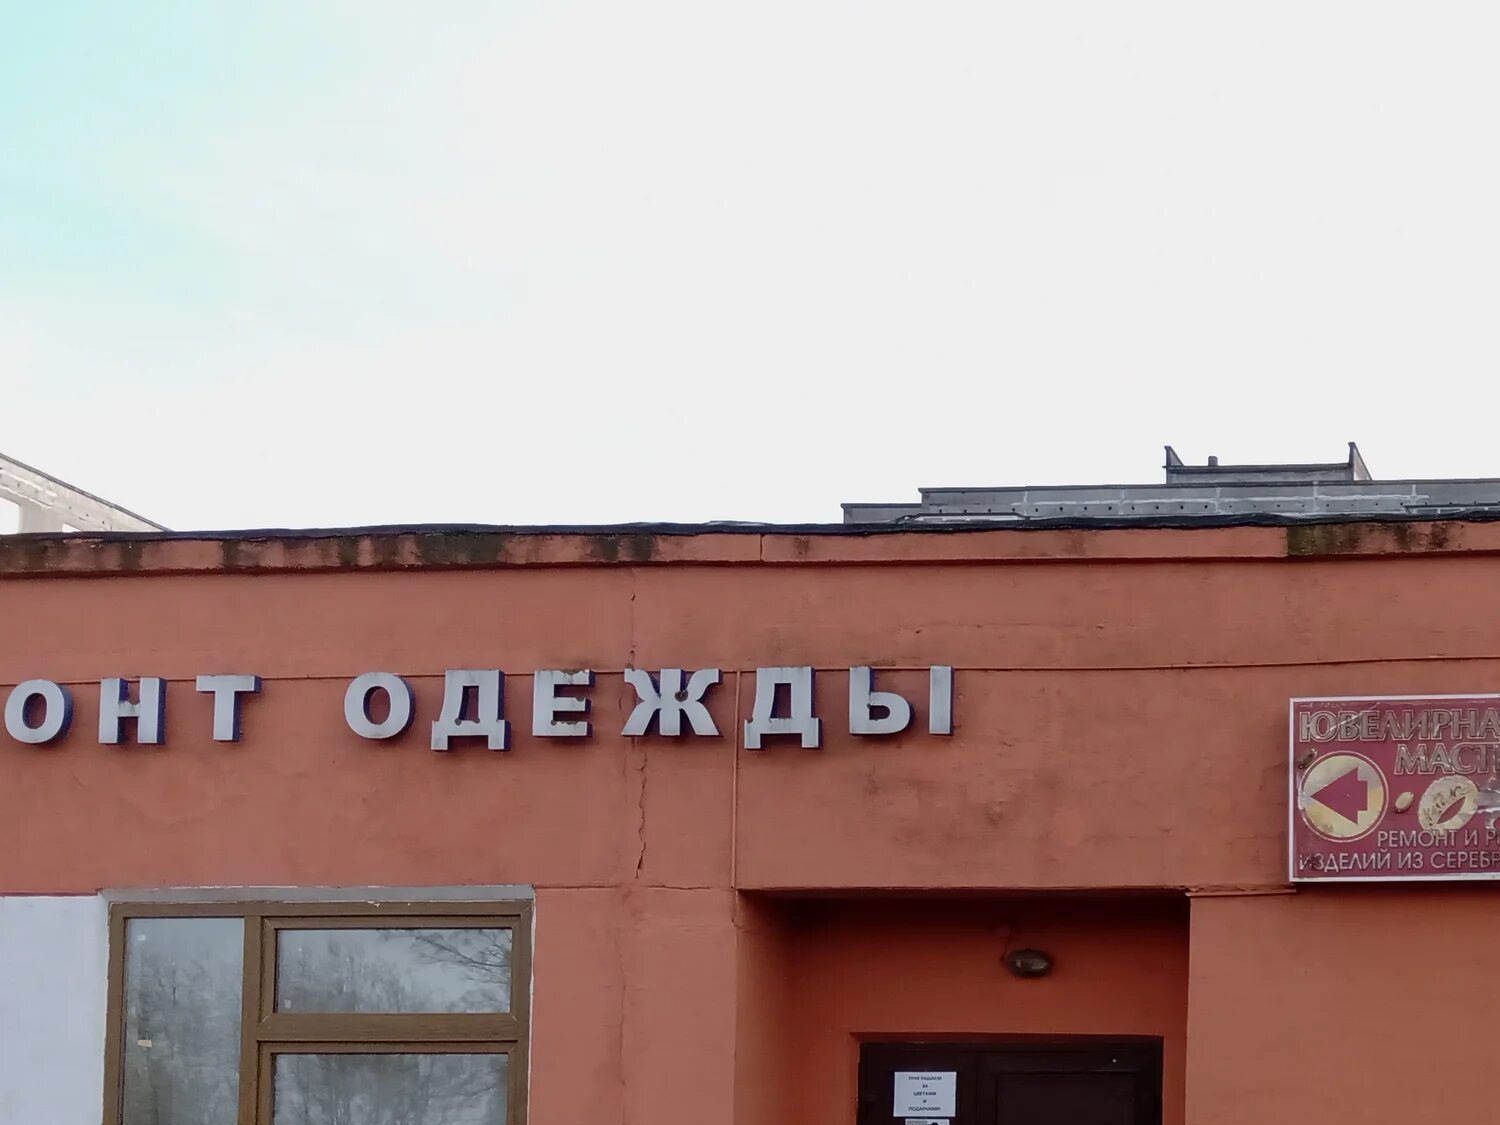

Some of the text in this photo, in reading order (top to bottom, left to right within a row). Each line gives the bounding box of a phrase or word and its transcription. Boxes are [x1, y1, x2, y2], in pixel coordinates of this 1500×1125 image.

[4, 665, 957, 752] ОНТ ОДЕЖДЫ
[1377, 829, 1458, 848] РЕМОНТ
[1464, 828, 1479, 847] И
[1299, 848, 1392, 872] ИЗДЕЛИЙ
[1398, 851, 1424, 869] ИЗ
